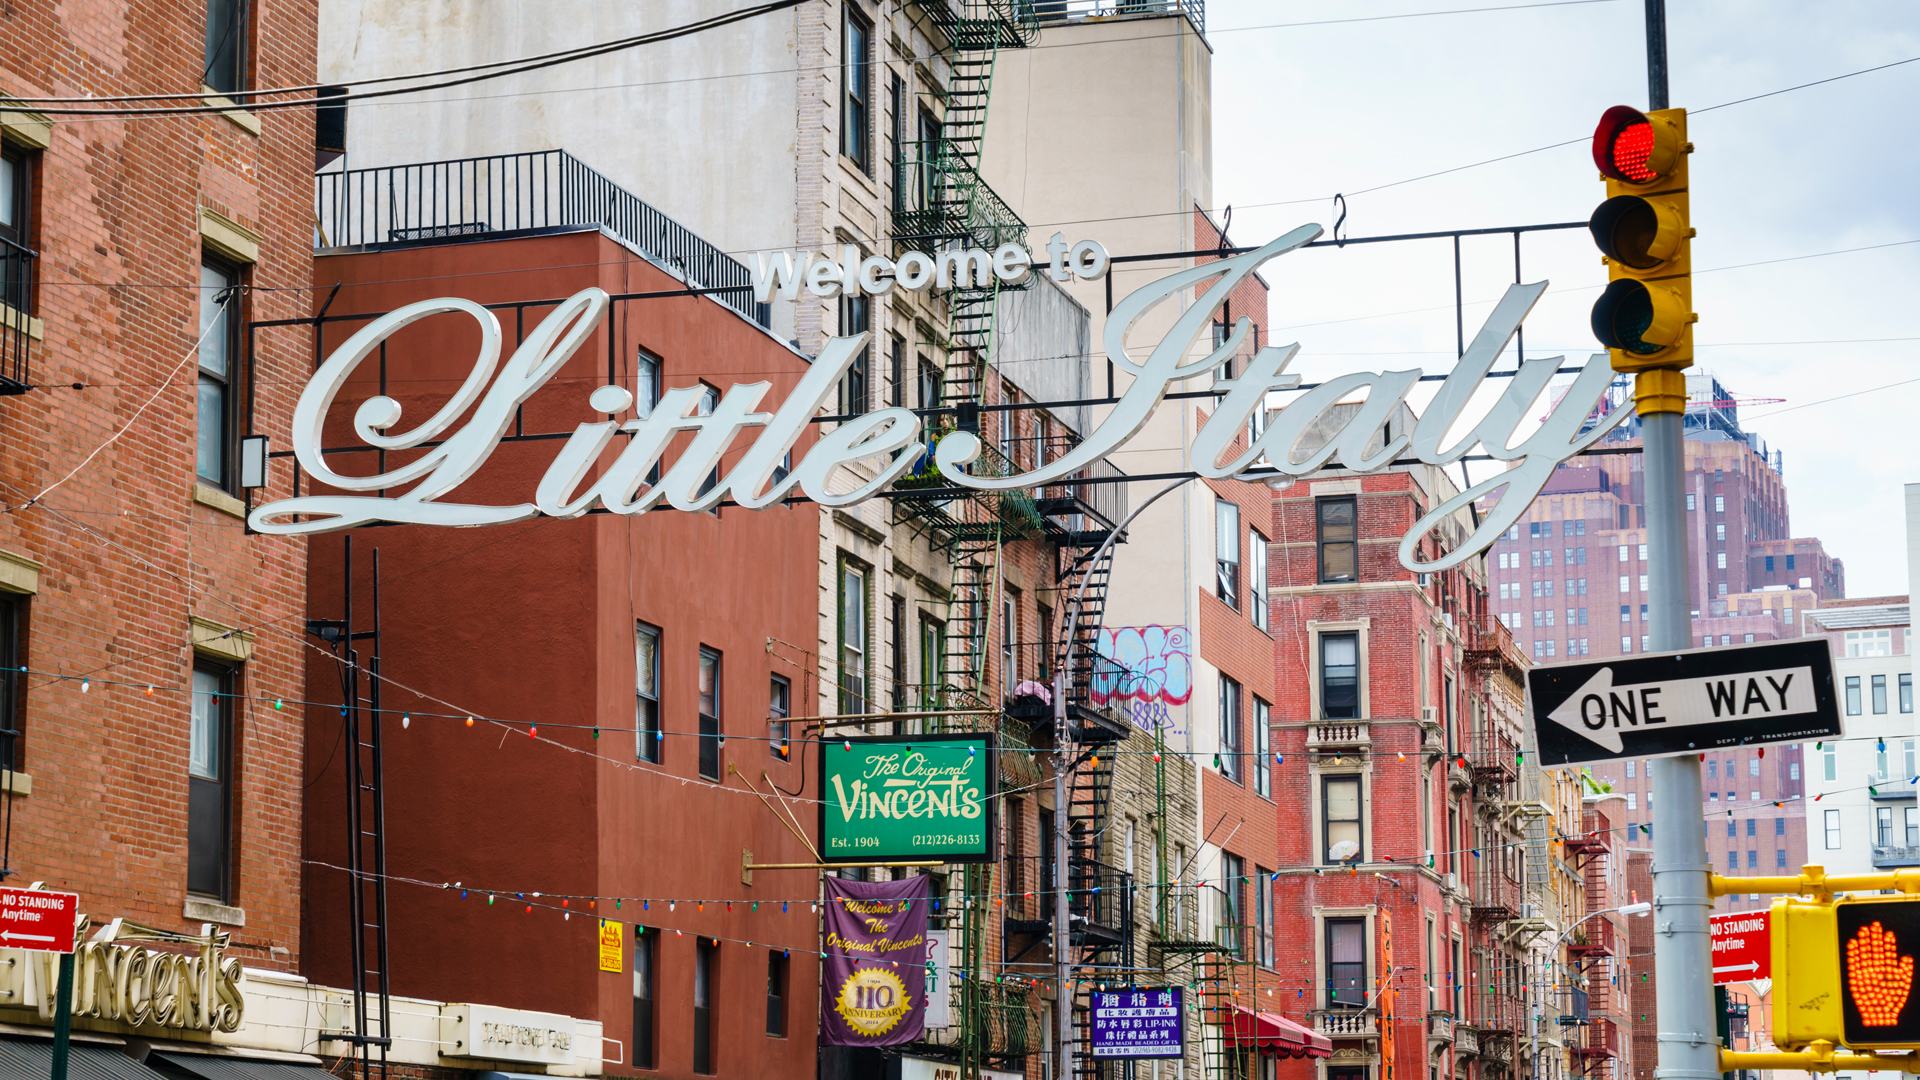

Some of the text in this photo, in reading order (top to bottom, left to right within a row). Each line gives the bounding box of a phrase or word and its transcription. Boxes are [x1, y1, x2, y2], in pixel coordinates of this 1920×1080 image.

[747, 231, 1110, 303] Welcome to
[246, 222, 1637, 574] Little Italy
[1580, 673, 1794, 731] ONE WAY
[1716, 737, 1736, 745] DEPT
[1762, 728, 1830, 740] TRANSPORTATION
[863, 752, 974, 789] The Original
[832, 834, 980, 848] Est. 1904 (212)226-8133
[2, 894, 64, 911] NO STANDING
[844, 898, 894, 914] Welcome
[2, 908, 41, 922] Anytime
[865, 918, 889, 934] The
[1710, 918, 1764, 936] NO STANDING
[826, 932, 876, 953] Original
[877, 933, 923, 953] Vincents
[1711, 938, 1745, 953] Anytime
[842, 1006, 904, 1018] ANNIVERSARY
[1145, 1019, 1177, 1028] LIP-INK
